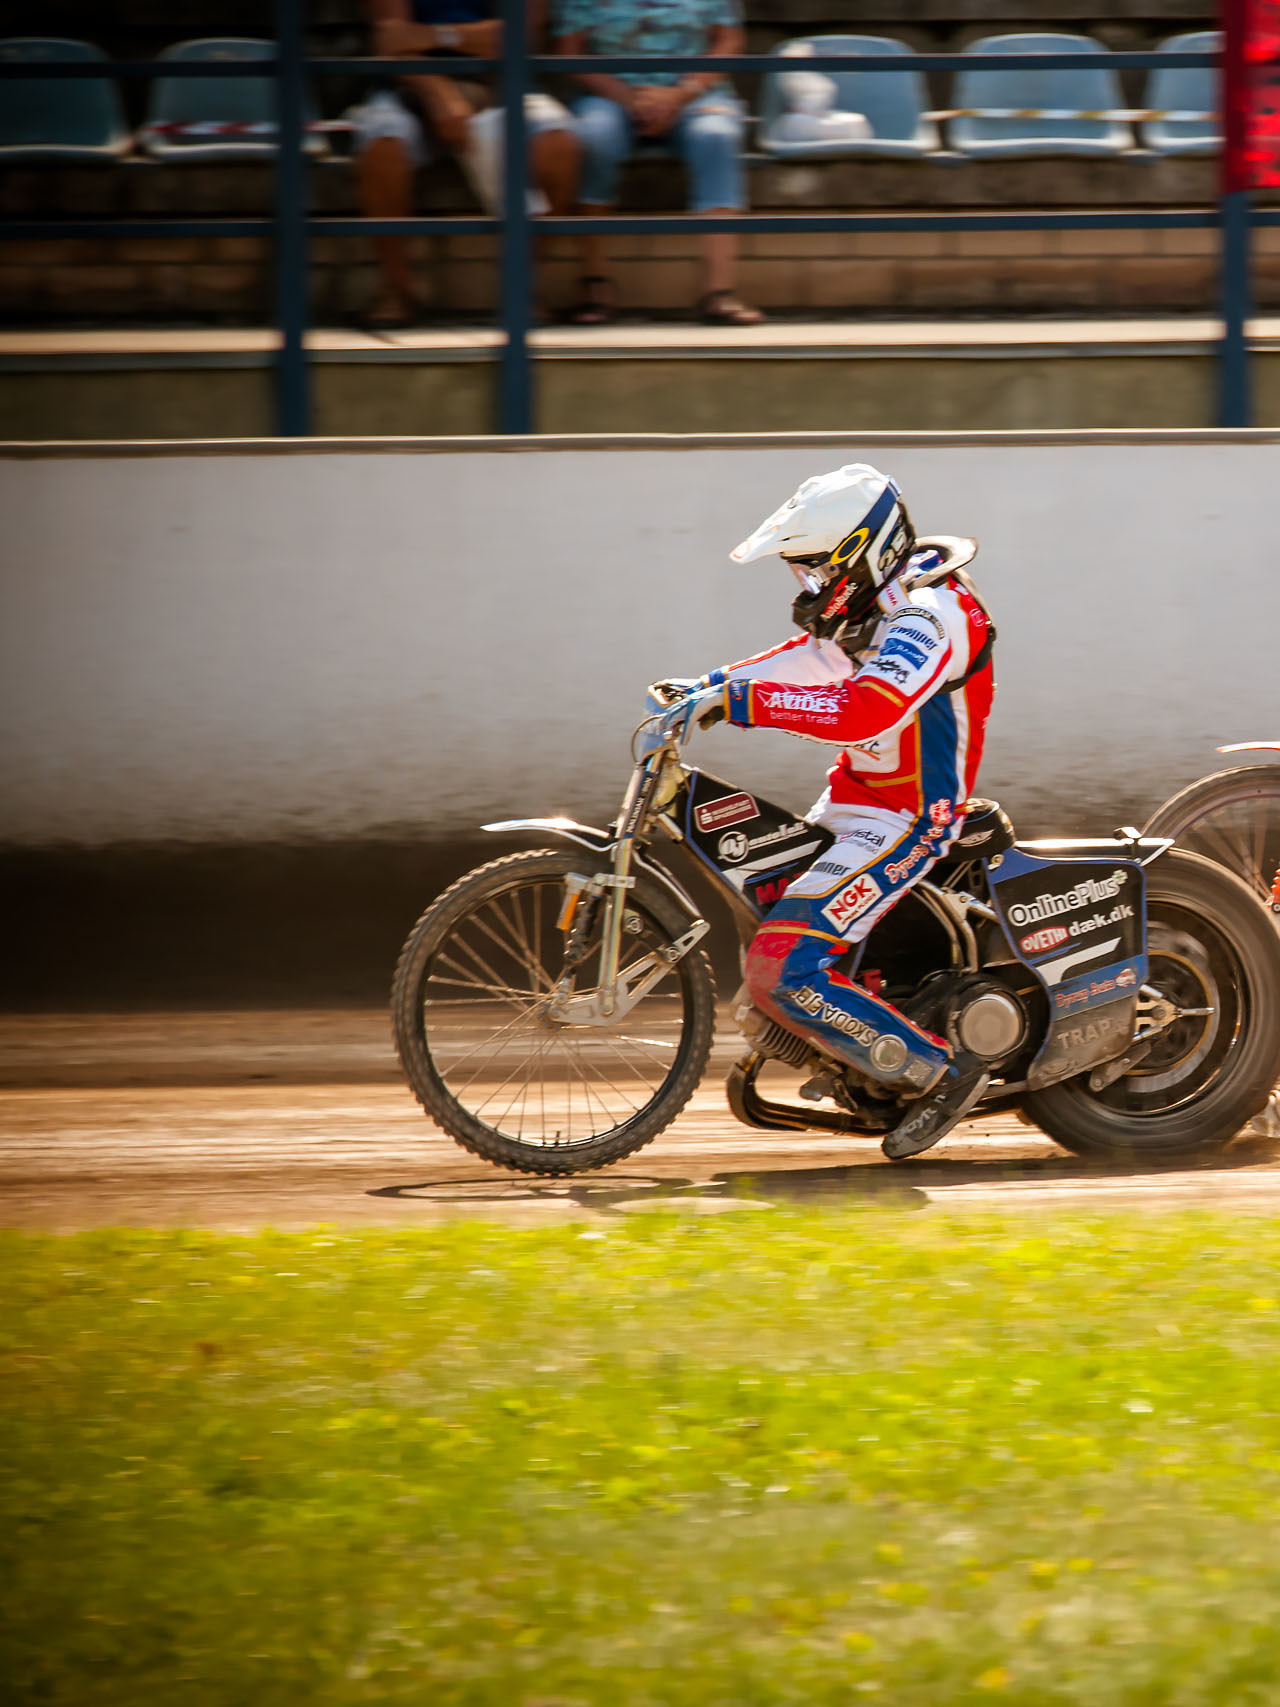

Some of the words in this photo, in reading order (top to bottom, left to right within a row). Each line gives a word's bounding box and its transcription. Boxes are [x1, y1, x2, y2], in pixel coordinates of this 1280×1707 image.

[769, 710, 802, 721] better
[806, 712, 838, 725] trade
[829, 878, 872, 920] NGK
[1008, 878, 1121, 926] OnlinePlus
[1068, 904, 1135, 936] dæk.dk
